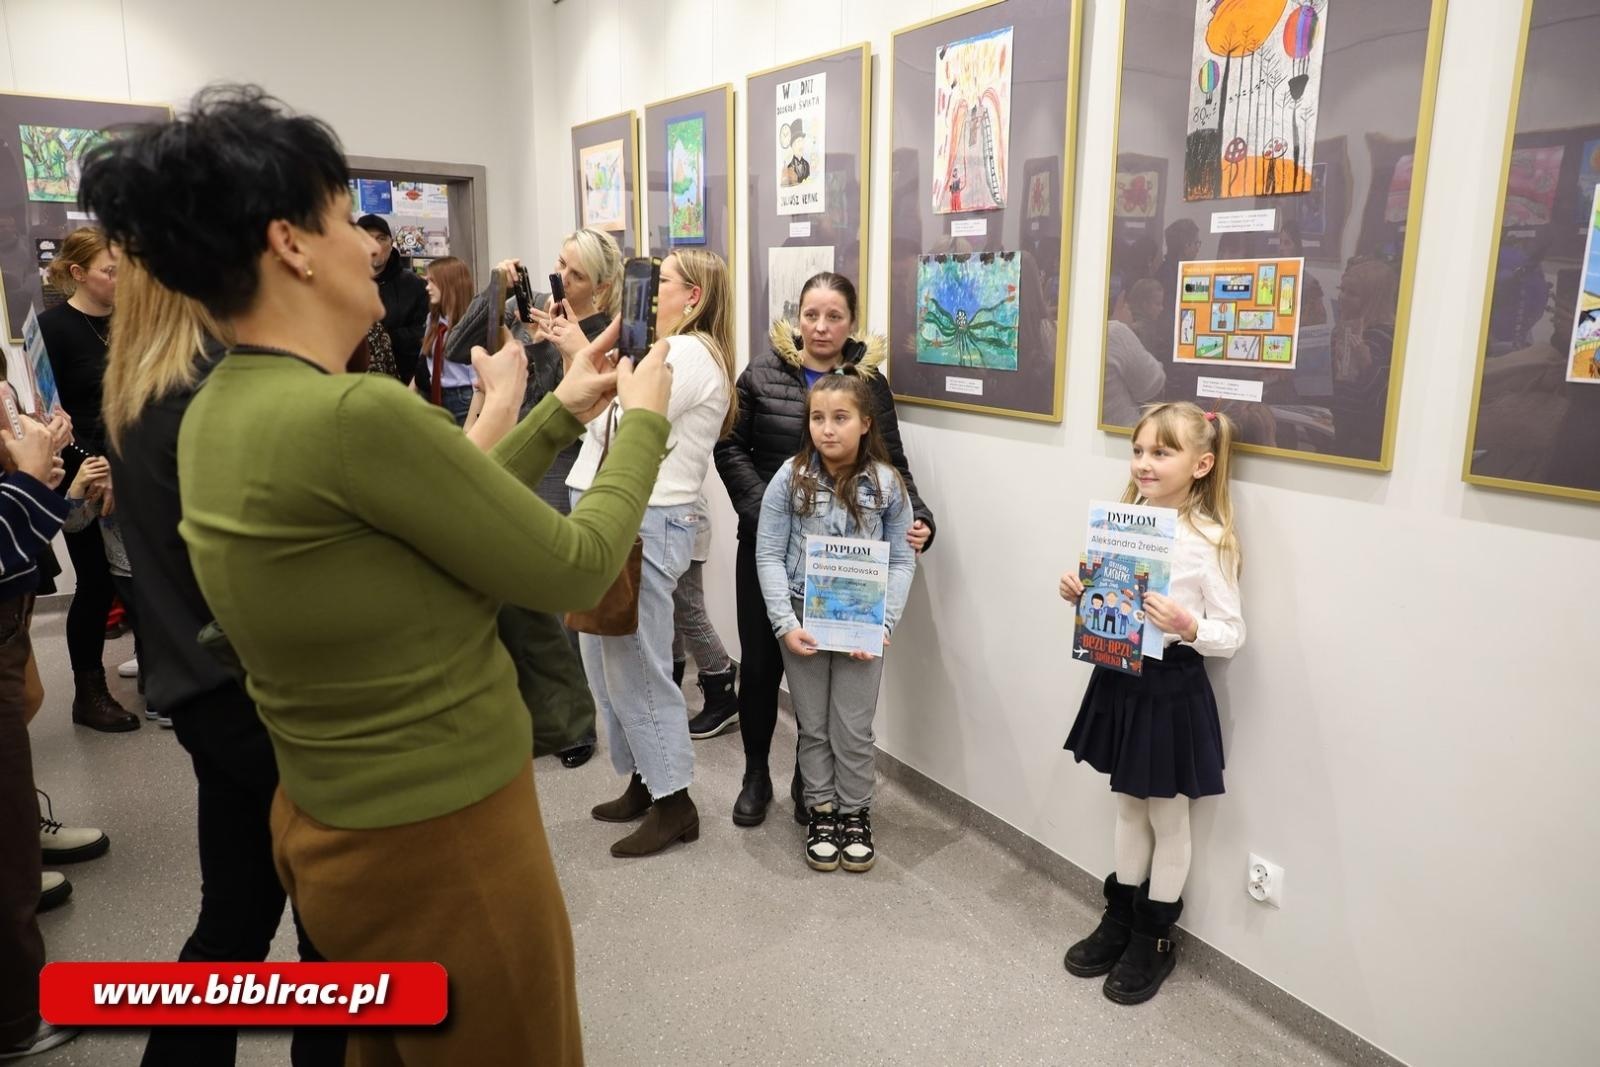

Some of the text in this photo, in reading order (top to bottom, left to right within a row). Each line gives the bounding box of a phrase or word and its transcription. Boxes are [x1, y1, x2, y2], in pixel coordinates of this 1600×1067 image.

[1107, 511, 1156, 527] DYPLOM
[1091, 535, 1137, 549] Aleksandra
[824, 543, 871, 556] DYPLOM
[812, 562, 879, 576] Oliwia Kozłowska
